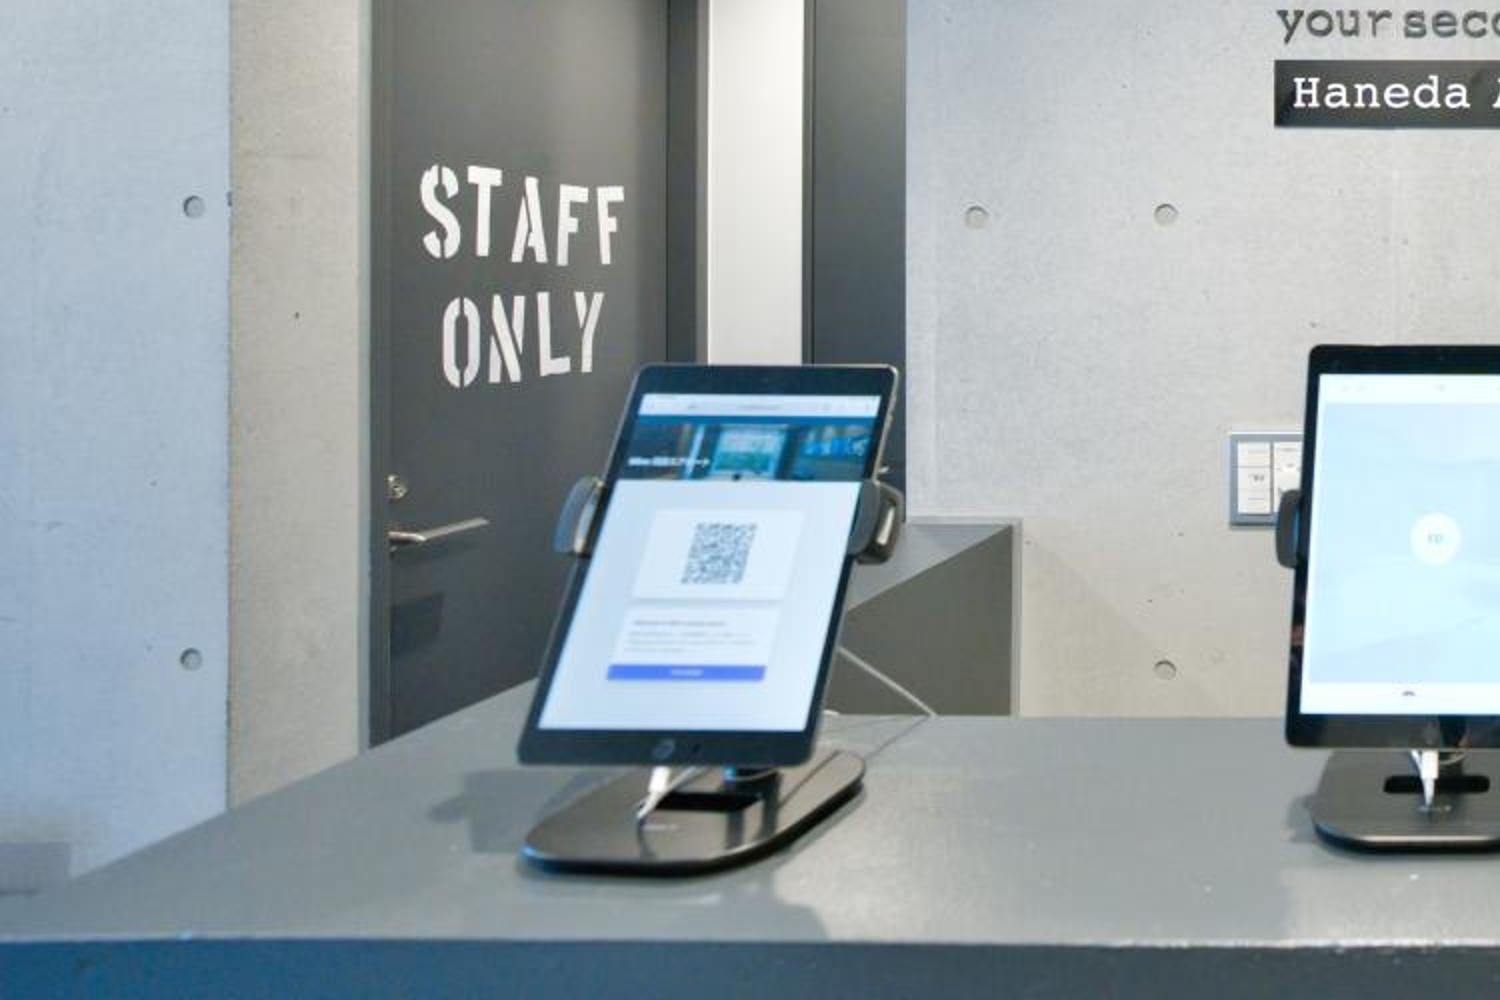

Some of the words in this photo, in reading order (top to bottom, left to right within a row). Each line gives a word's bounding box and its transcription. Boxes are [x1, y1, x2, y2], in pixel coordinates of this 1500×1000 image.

[1276, 7, 1392, 44] your
[1292, 75, 1470, 109] Haneda
[419, 163, 625, 267] STAFF
[442, 291, 605, 389] ONLY
